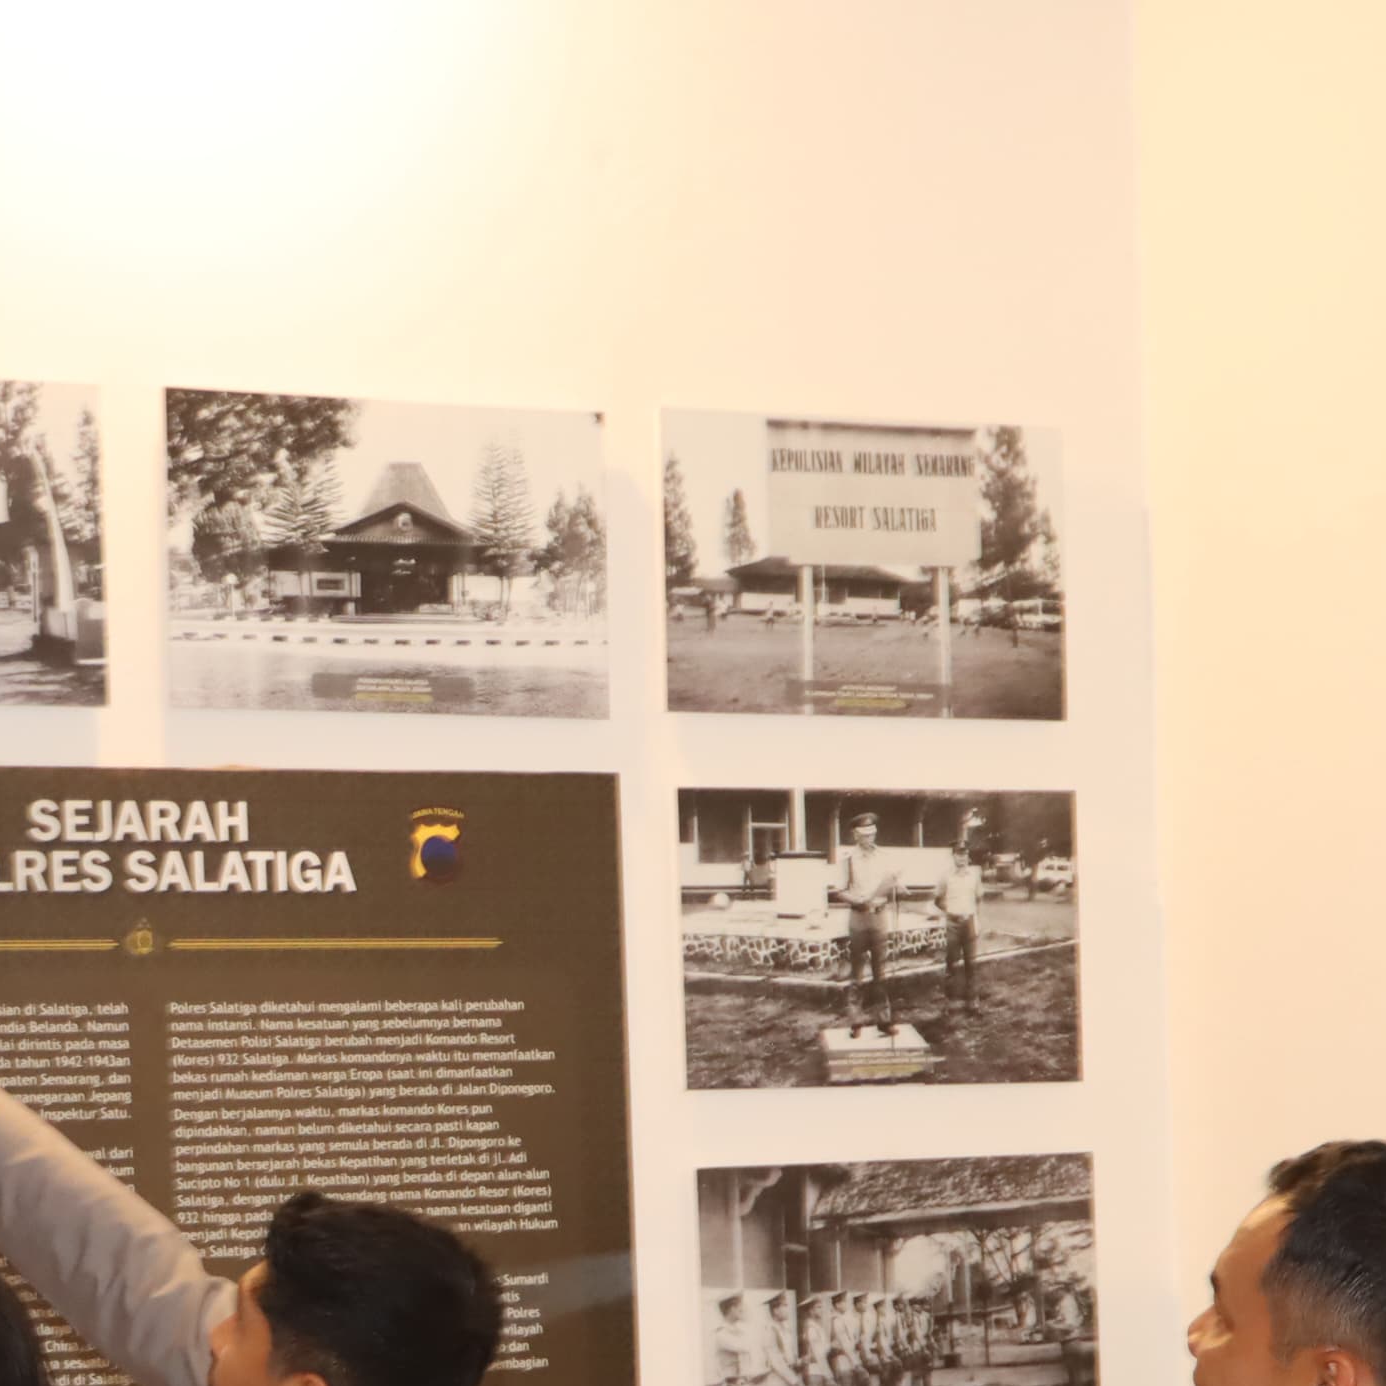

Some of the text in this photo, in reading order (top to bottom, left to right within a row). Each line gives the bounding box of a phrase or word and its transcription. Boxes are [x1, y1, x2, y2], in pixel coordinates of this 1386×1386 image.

[771, 448, 974, 477] KEPOLISIAN WILAYAH SEMARANG
[814, 505, 936, 532] RESORT SALATIGA
[29, 798, 250, 844] SEJARAH
[125, 848, 356, 894] SALATIGA
[98, 1002, 129, 1015] telah
[170, 1001, 206, 1014] Polres
[210, 1001, 256, 1016] Salatiga
[385, 999, 438, 1015] beberapa
[442, 999, 461, 1012] kali
[87, 1020, 130, 1032] Namun
[171, 1020, 203, 1030] nama
[261, 1017, 293, 1029] Nama
[297, 1017, 349, 1029] kesatuan
[353, 1019, 379, 1032] yang
[453, 1016, 503, 1028] bernama
[18, 1037, 61, 1050] dirintis
[65, 1036, 94, 1052] pada
[98, 1038, 131, 1049] masa
[241, 1034, 271, 1047] Polisi
[276, 1034, 321, 1050] Salatiga
[325, 1034, 372, 1046] berubah
[376, 1033, 422, 1049] menjadi
[426, 1033, 477, 1045] Komando
[480, 1032, 517, 1045] Resort
[15, 1056, 50, 1069] tahun
[173, 1052, 214, 1068] (Kores)
[218, 1052, 238, 1064] 932
[297, 1051, 337, 1063] Markas
[416, 1050, 450, 1062] waktu
[454, 1049, 469, 1062] itu
[173, 1070, 206, 1083] bekas
[211, 1070, 248, 1082] rumah
[252, 1069, 308, 1082] kediaman
[312, 1071, 346, 1084] warga
[350, 1068, 382, 1084] Eropa
[387, 1068, 413, 1083] (saat
[419, 1067, 432, 1080] ini
[90, 1090, 132, 1106] Jepang
[173, 1087, 222, 1103] menjadi
[226, 1086, 273, 1099] Museum
[277, 1086, 311, 1099] Polres
[370, 1087, 396, 1100] yang
[399, 1084, 438, 1097] berada
[442, 1083, 452, 1096] di
[457, 1083, 486, 1096] Jalan
[174, 1107, 218, 1123] Dengan
[339, 1104, 379, 1117] markas
[383, 1103, 434, 1116] komando
[438, 1103, 468, 1115] Kores
[471, 1105, 494, 1118] pun
[256, 1125, 294, 1135] namun
[298, 1122, 334, 1135] belum
[395, 1122, 432, 1133] secara
[436, 1119, 462, 1135] pasti
[466, 1118, 501, 1134] kapan
[253, 1139, 294, 1152] markas
[299, 1141, 325, 1154] yang
[329, 1138, 369, 1151] semula
[373, 1137, 412, 1150] berada
[416, 1137, 427, 1149] di
[507, 1135, 523, 1147] ke
[176, 1158, 233, 1175] bangunan
[304, 1156, 336, 1169] bekas
[401, 1156, 427, 1169] yang
[431, 1153, 475, 1166] terletak
[508, 1151, 529, 1164] Adi
[176, 1176, 221, 1192] Sucipto
[224, 1176, 240, 1188] No
[255, 1174, 285, 1190] (dulu
[374, 1174, 399, 1187] yang
[403, 1170, 442, 1183] berada
[446, 1170, 456, 1182] di
[461, 1169, 494, 1185] depan
[233, 1192, 275, 1208] dengan
[390, 1190, 421, 1201] nama
[425, 1187, 475, 1200] Komando
[479, 1186, 507, 1199] Resor
[513, 1185, 552, 1201] (Kores)
[203, 1210, 241, 1226] hingga
[245, 1209, 274, 1225] pada
[425, 1206, 457, 1217] nama
[461, 1202, 510, 1216] kesatuan
[513, 1201, 554, 1217] diganti
[474, 1218, 516, 1235] wilayah
[520, 1217, 559, 1230] Hukum
[209, 1244, 258, 1260] Salatiga
[501, 1271, 550, 1287] Sumardi
[507, 1306, 542, 1319] Polres
[508, 1340, 530, 1352] dan
